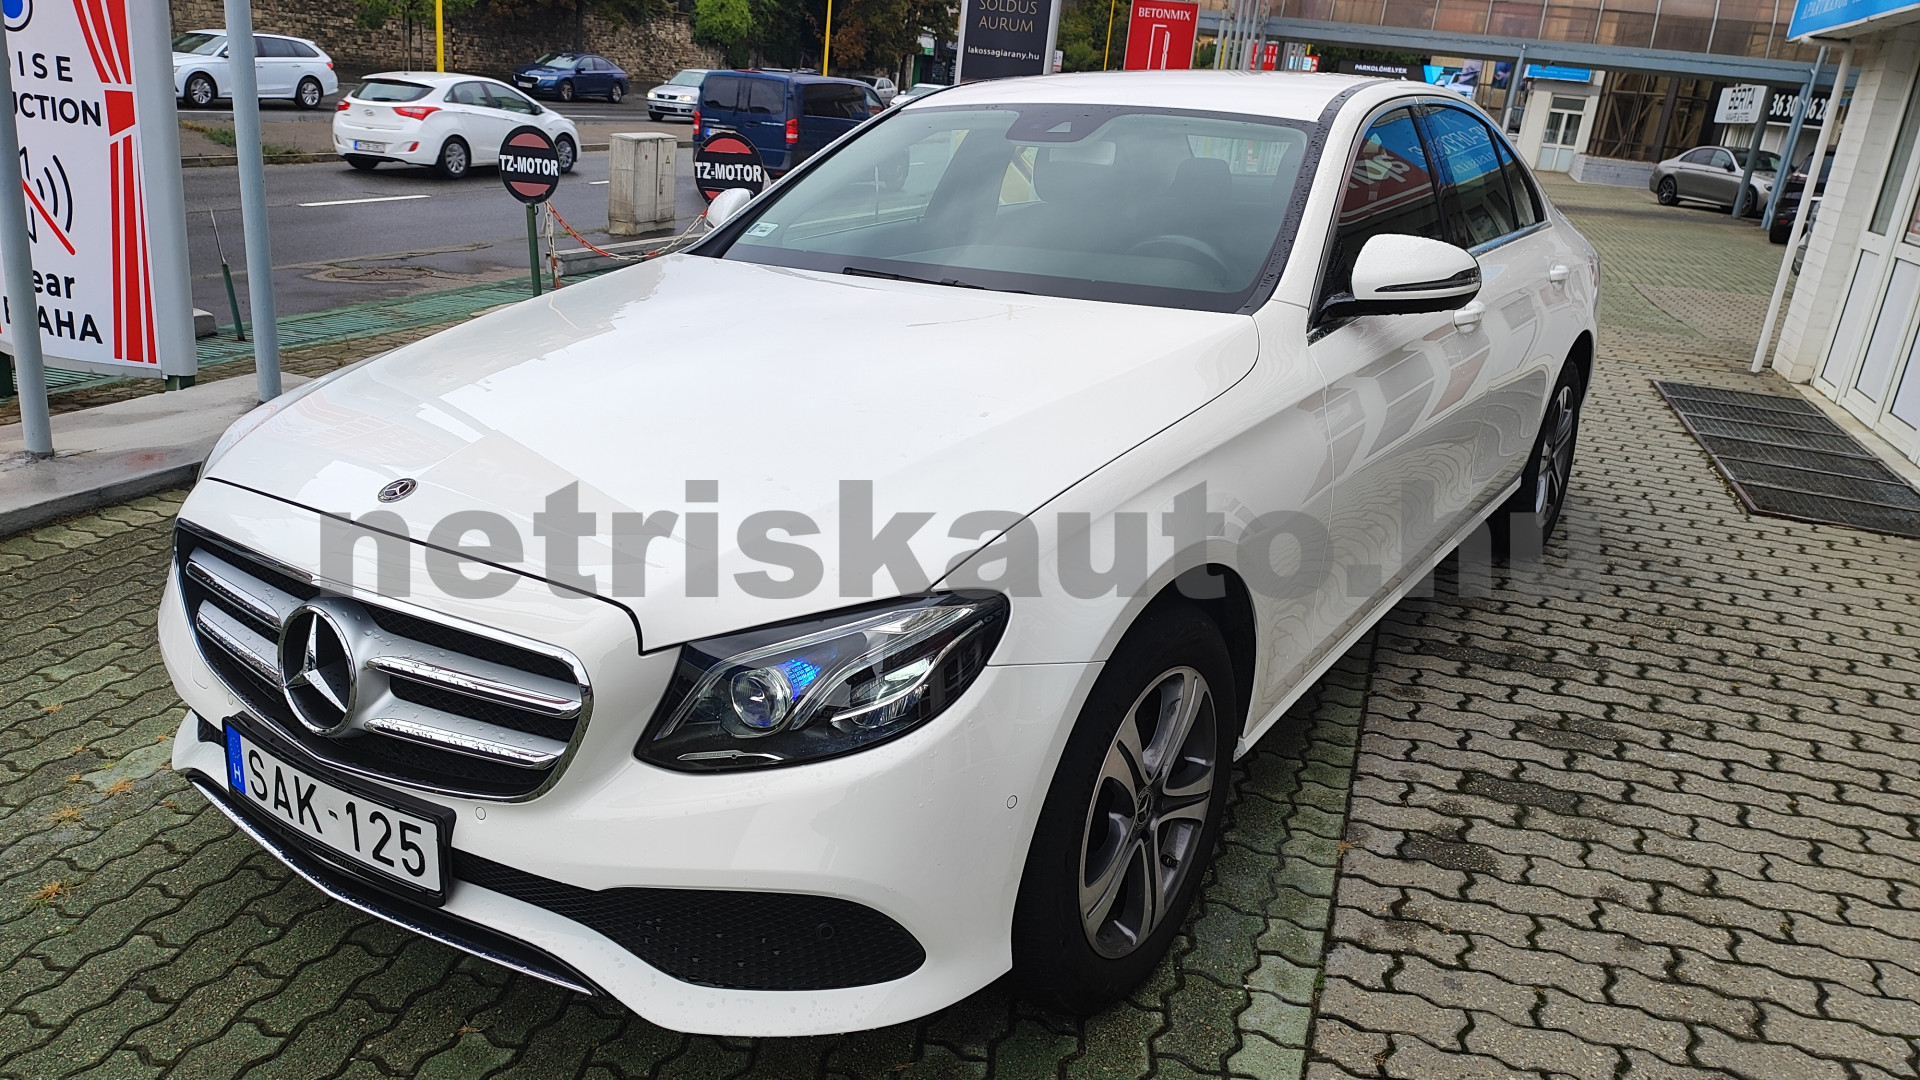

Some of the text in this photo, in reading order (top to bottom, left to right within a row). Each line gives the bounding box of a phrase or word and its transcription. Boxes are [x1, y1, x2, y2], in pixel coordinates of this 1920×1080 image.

[979, 0, 1037, 15] SOLDUS
[1138, 6, 1191, 21] BETONMIX
[979, 15, 1033, 33] AURUM
[967, 45, 1040, 61] lakossagiarany.hu
[9, 51, 73, 82] ISE
[500, 154, 559, 177] TZ-MOTOR
[694, 161, 762, 182] TZ-MOTOR
[33, 269, 75, 299] ear
[233, 762, 242, 783] H
[248, 749, 426, 877] SAK-125
